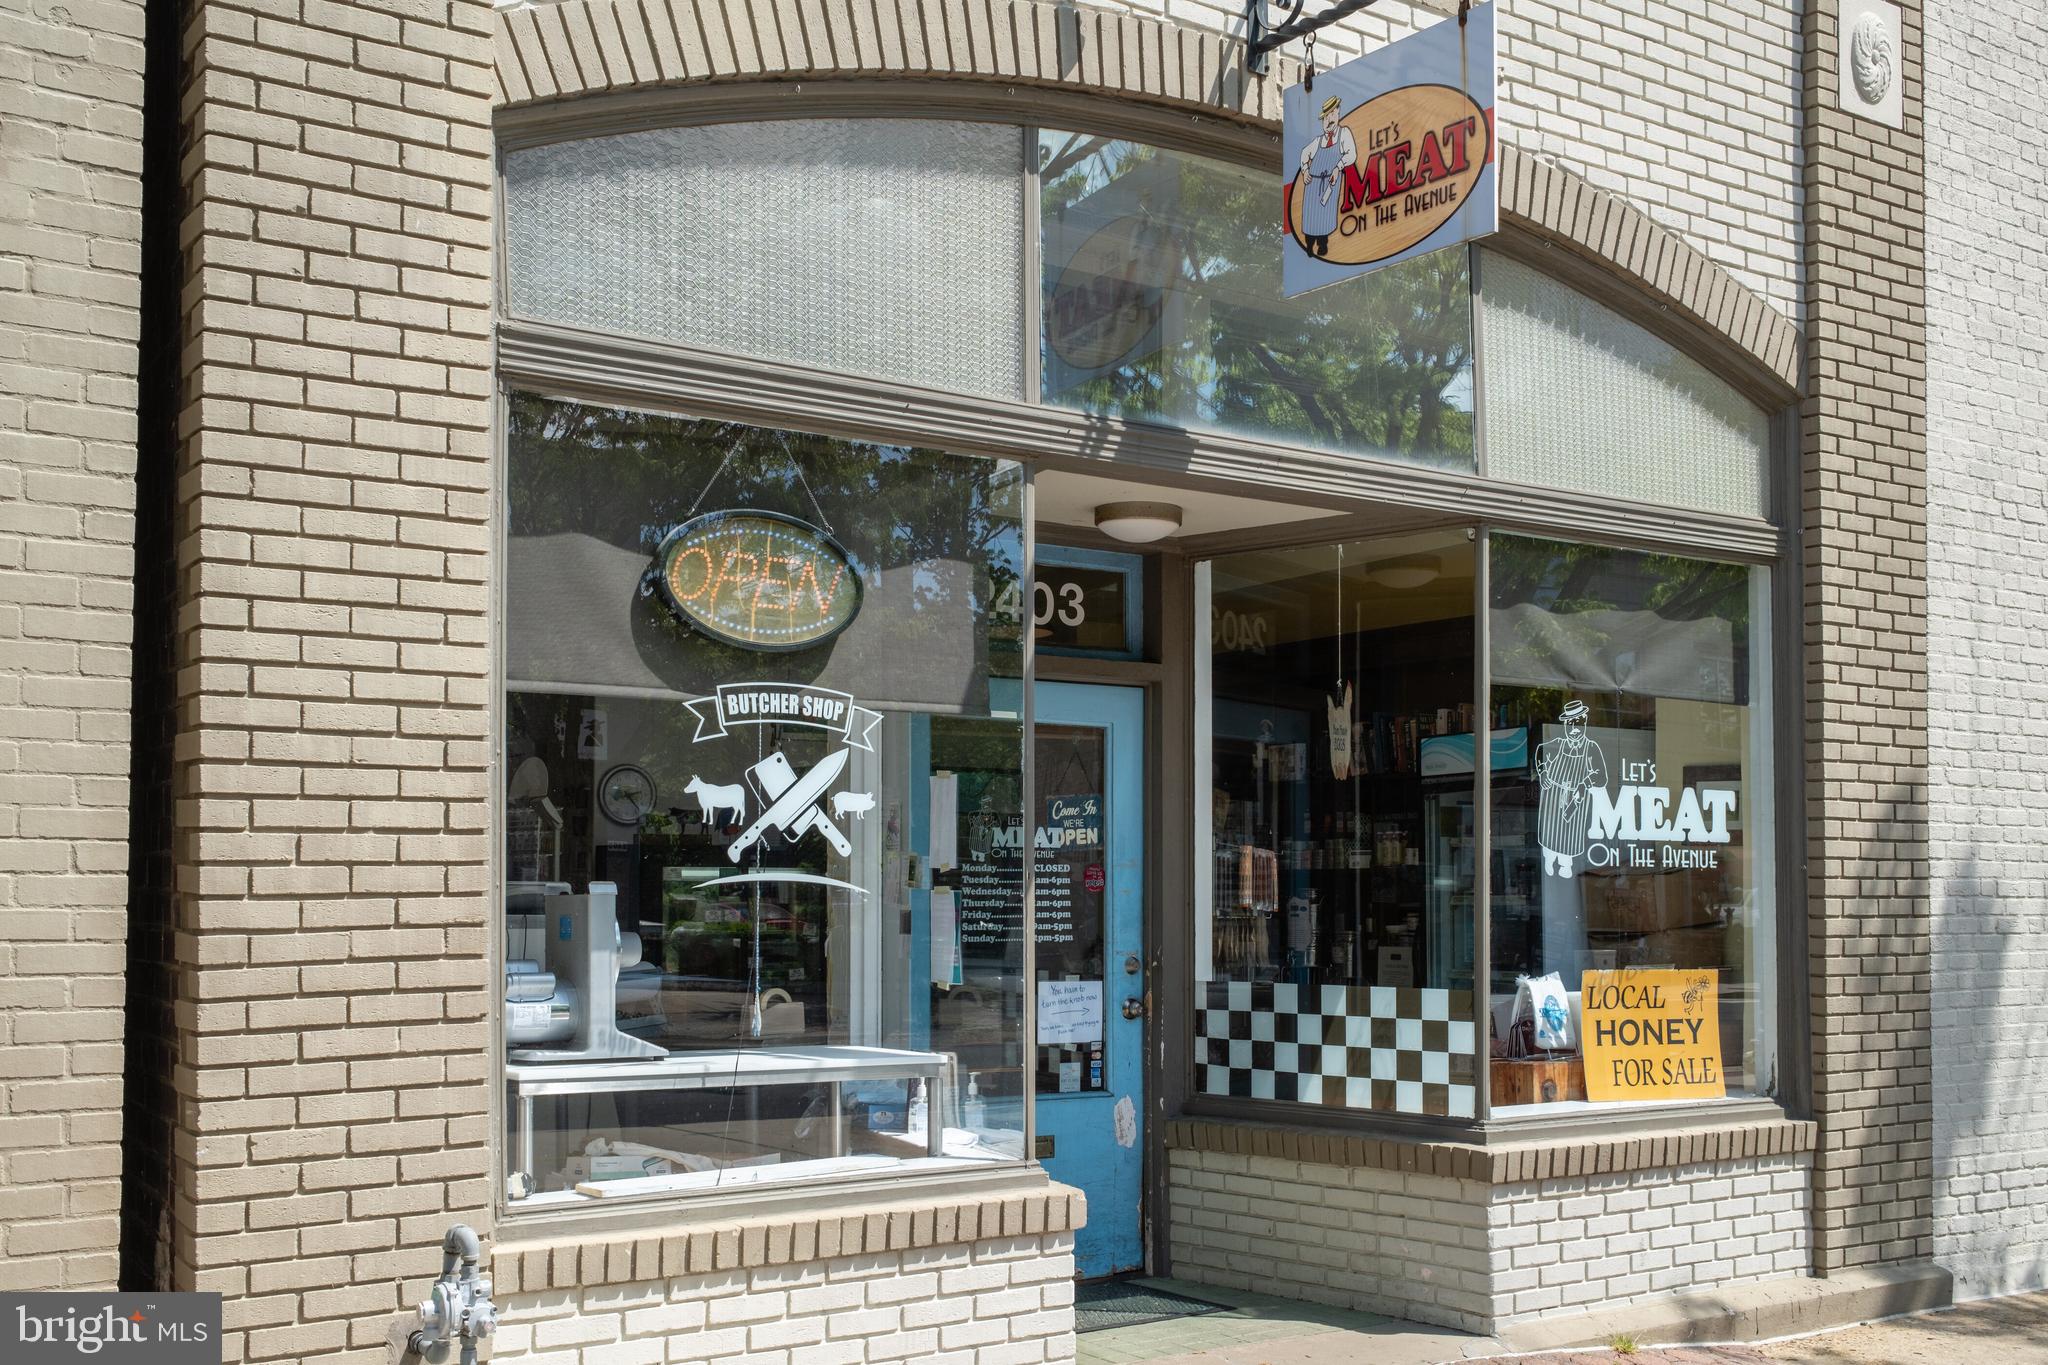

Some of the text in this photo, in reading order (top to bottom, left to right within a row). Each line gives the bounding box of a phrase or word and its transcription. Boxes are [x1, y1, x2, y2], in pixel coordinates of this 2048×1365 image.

[1369, 121, 1399, 150] LET'S
[1340, 116, 1475, 213] MEAT
[1340, 183, 1457, 236] ON THE AVENUE
[672, 547, 843, 615] OPEN
[726, 692, 844, 721] BUTCHER SHOP
[1622, 758, 1656, 783] LET'S
[1052, 799, 1097, 820] Come In
[1063, 819, 1084, 828] WE'RE
[1588, 785, 1736, 843] MEAT
[1034, 864, 1070, 872] CLOSED
[1588, 843, 1718, 868] ON THE AVENUE
[1587, 985, 1666, 1009] LOCAL
[1595, 1018, 1704, 1046] HONEY
[1612, 1057, 1716, 1087] FOR SALE
